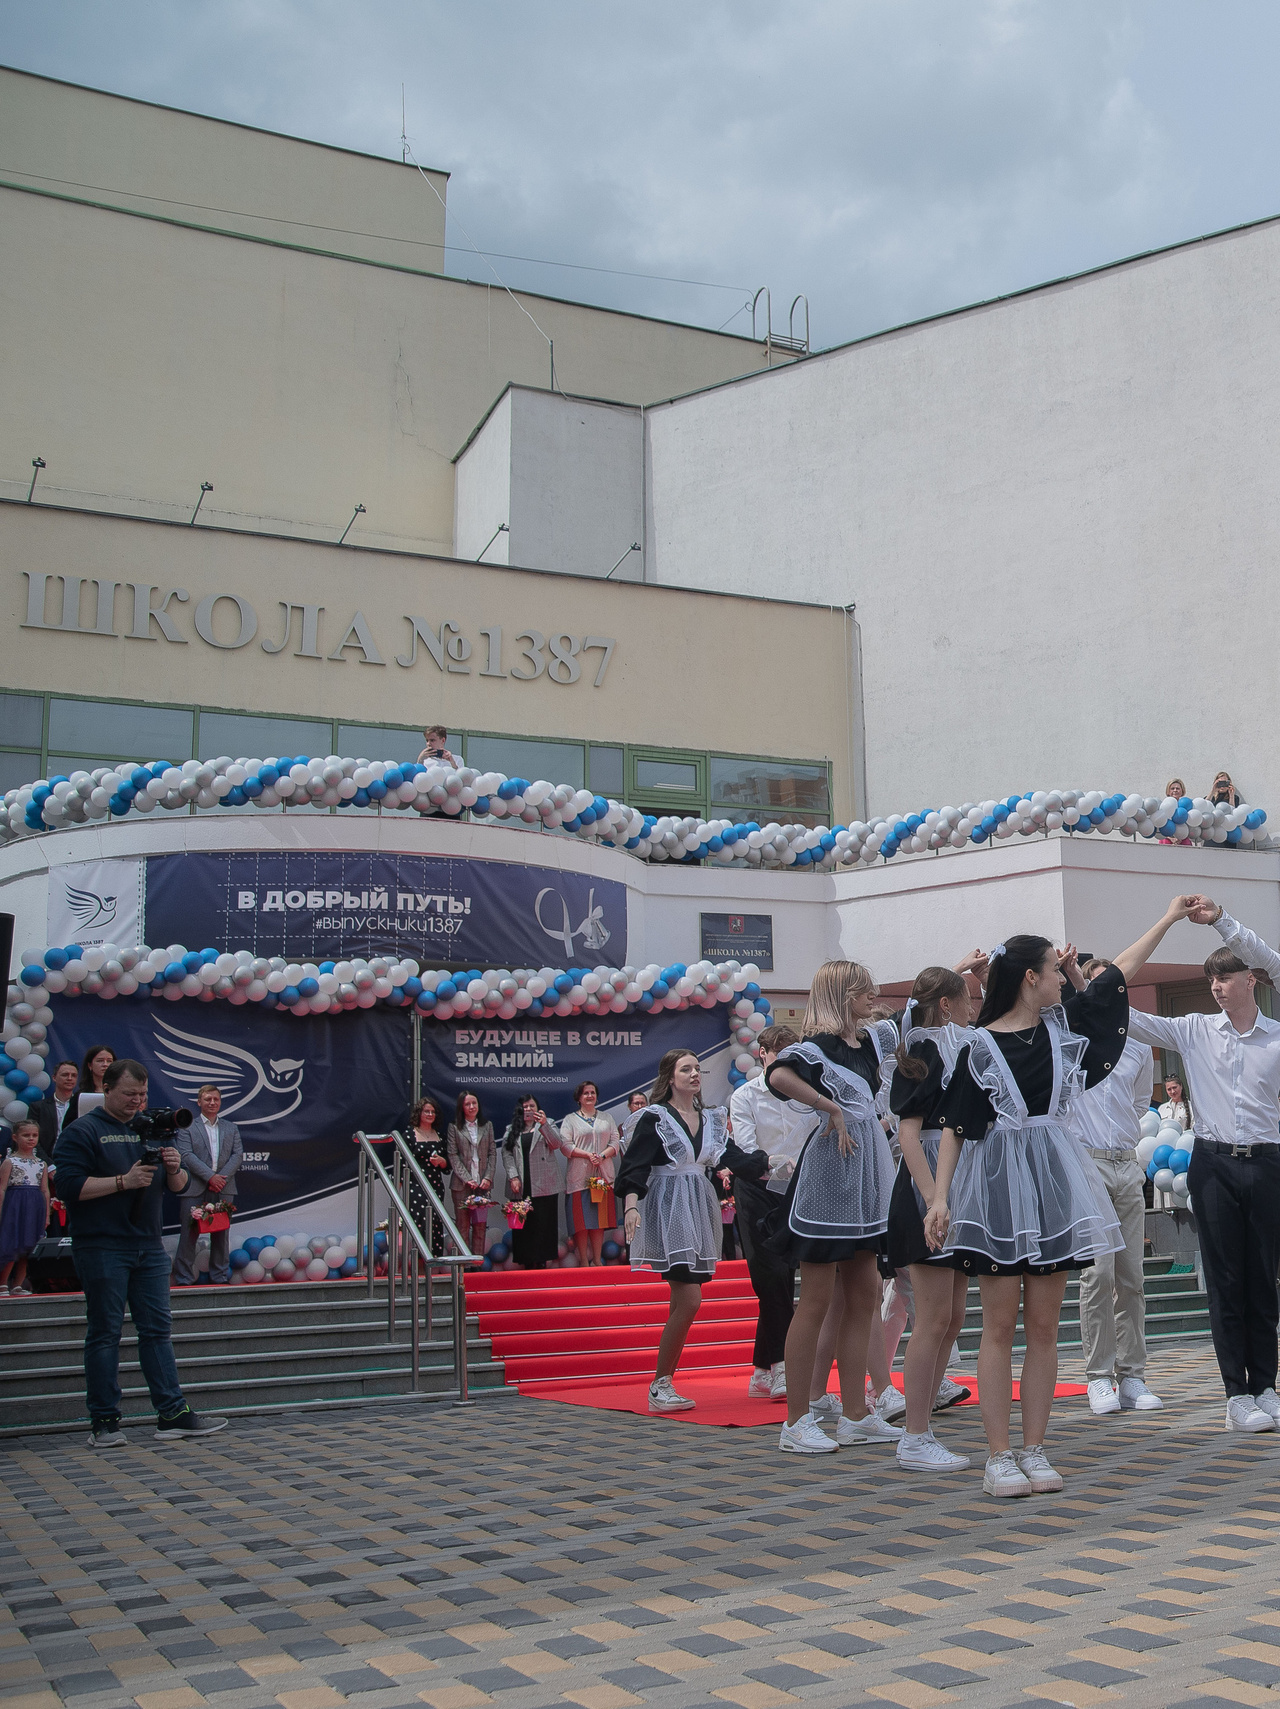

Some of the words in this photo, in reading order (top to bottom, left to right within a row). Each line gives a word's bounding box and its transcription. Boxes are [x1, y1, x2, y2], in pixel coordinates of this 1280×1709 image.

[20, 571, 386, 666] ШКОЛА
[237, 890, 256, 910] В
[262, 886, 389, 912] ДОБРЫЙ
[397, 893, 472, 915] ПУТЬ!
[455, 1029, 562, 1048] БУДУЩЕЕ
[567, 1031, 581, 1046] В
[585, 1031, 643, 1046] СИЛЕ
[455, 1049, 554, 1068] ЗНАНИЙ!
[455, 1075, 569, 1084] #ШКОЛЫКОЛЛЕДЖИМОСКВЫ
[242, 1152, 271, 1162] 1387
[240, 1163, 269, 1172] ЗНАНИЙ
